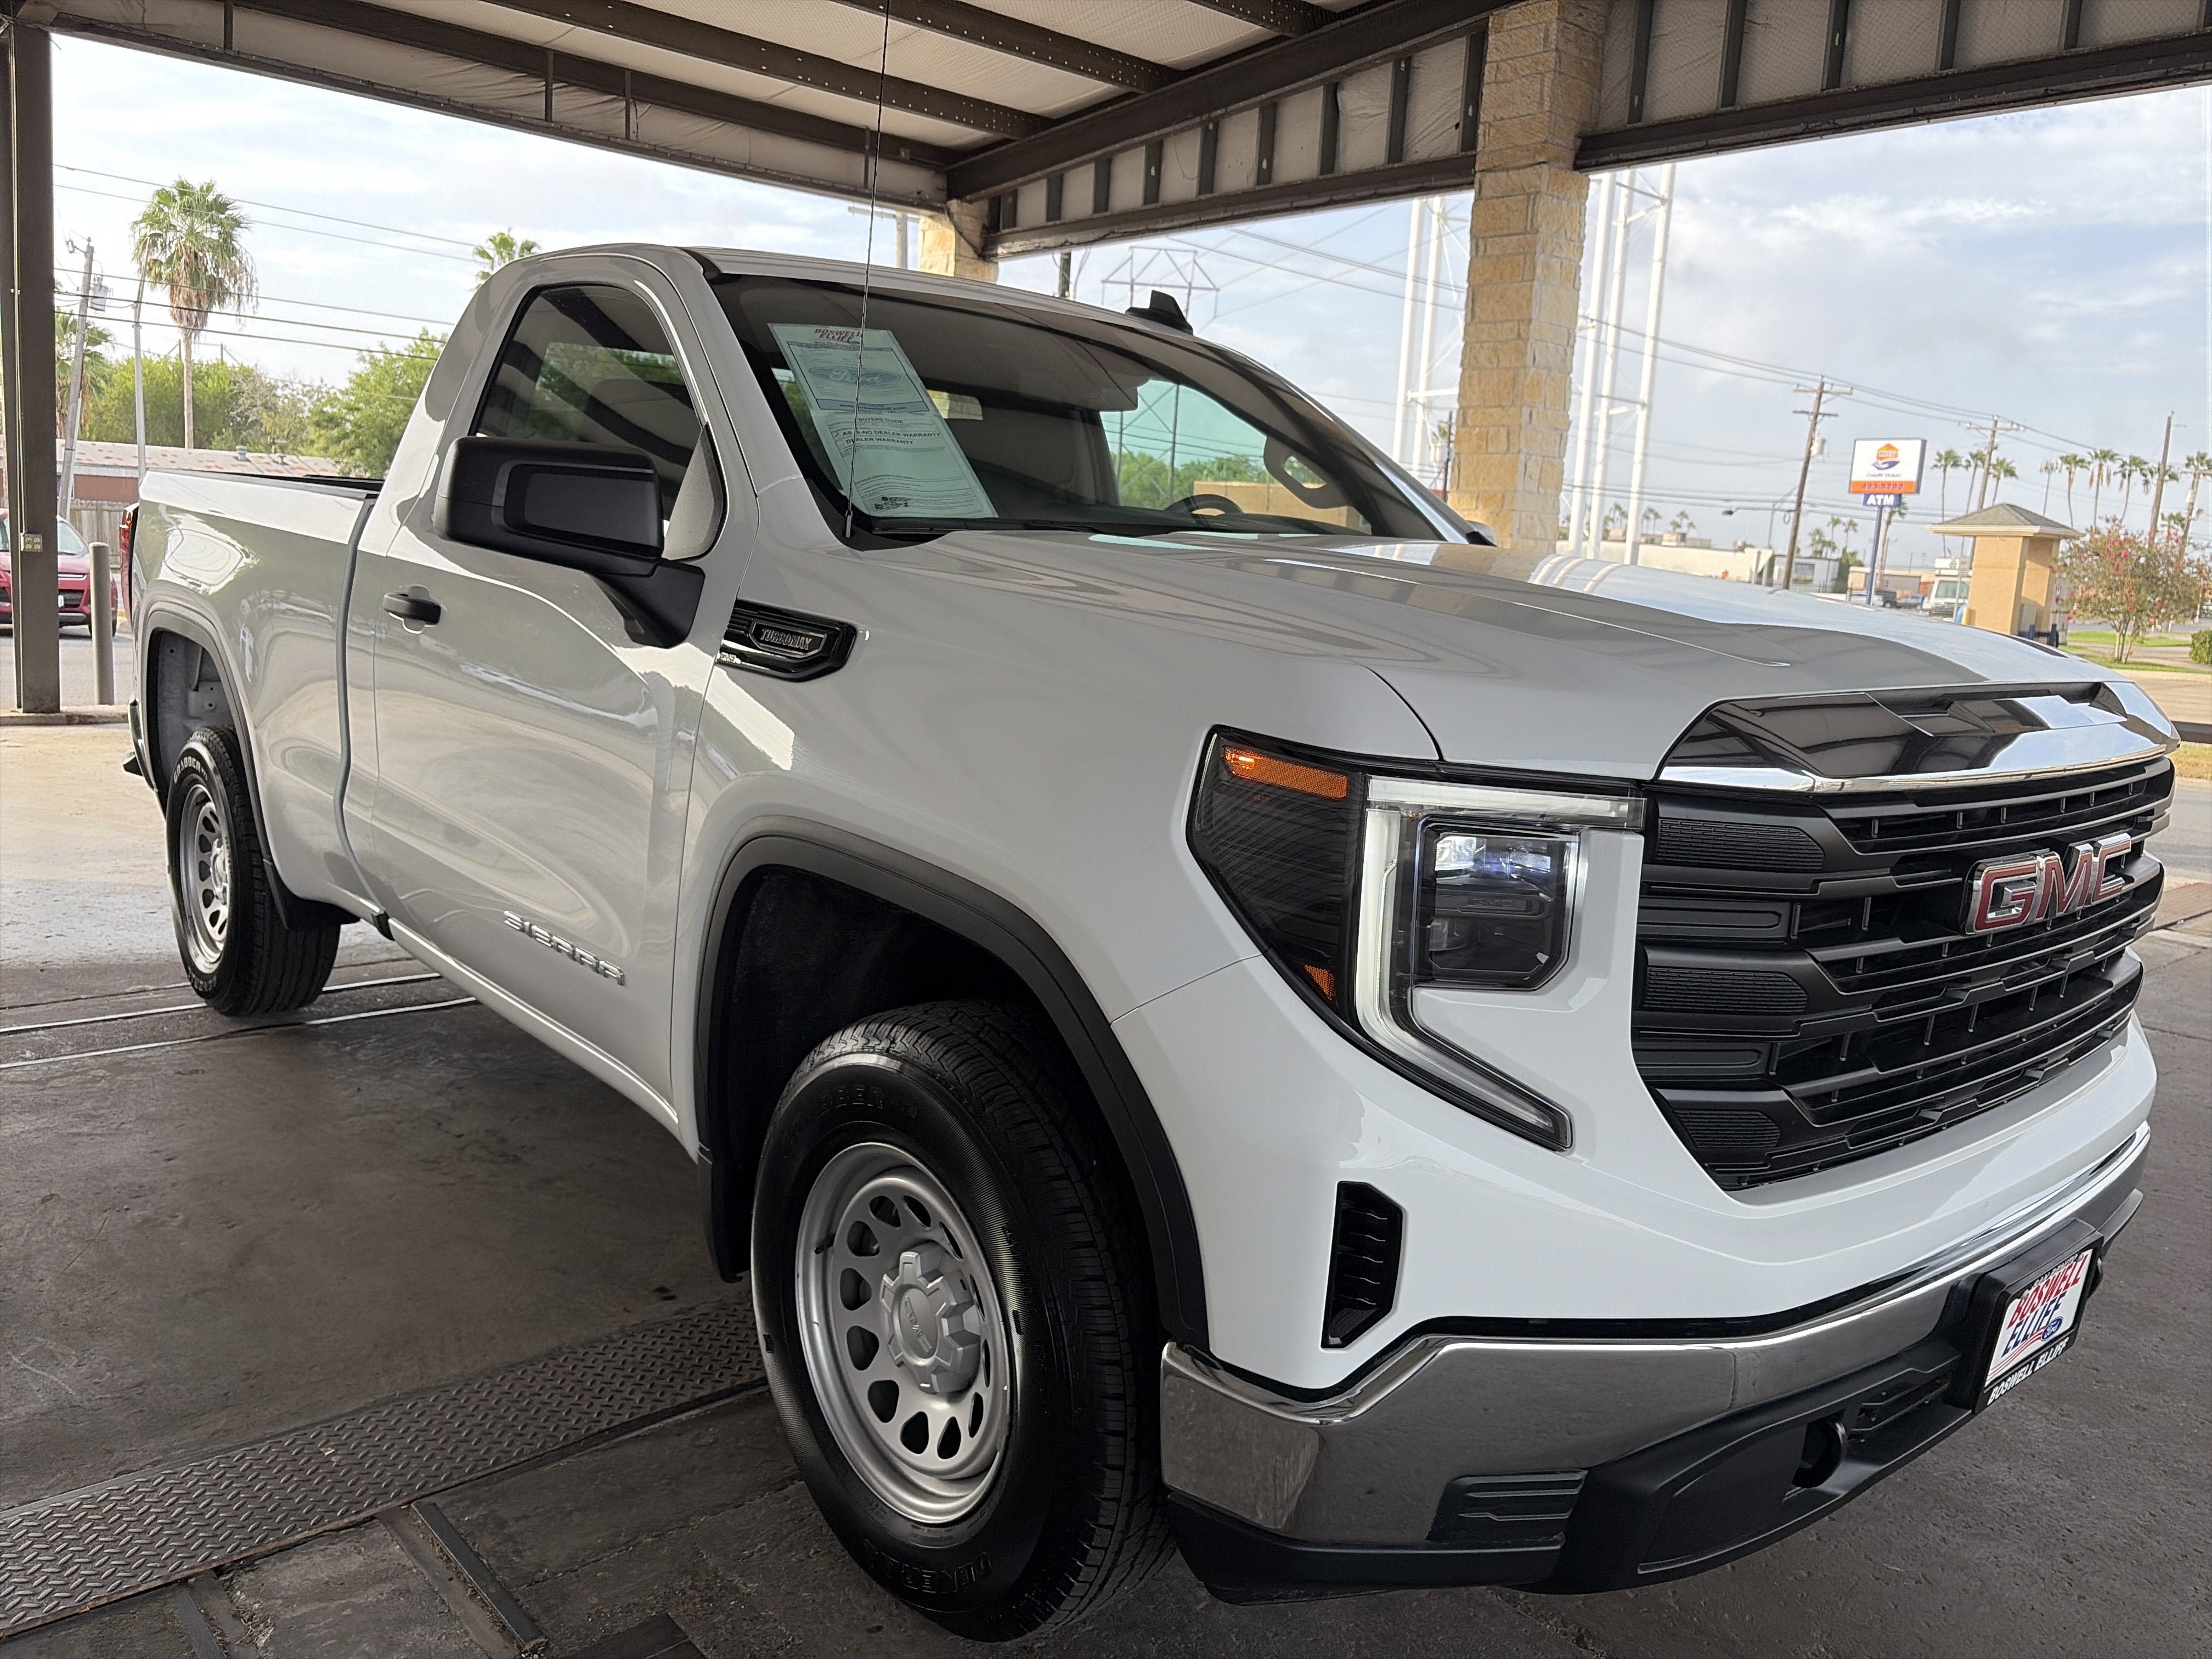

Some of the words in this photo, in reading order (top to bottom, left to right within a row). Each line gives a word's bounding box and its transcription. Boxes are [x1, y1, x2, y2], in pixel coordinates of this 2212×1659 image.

[814, 329, 862, 337] BOSWELL
[819, 334, 854, 342] ELLIFF
[1867, 494, 1894, 505] ATM
[760, 628, 813, 651] TURBOMAX
[173, 755, 201, 784] GRABBER
[1966, 833, 2132, 934] GMC
[503, 910, 625, 986] SIERRA
[2006, 1254, 2089, 1330] BOSWELL
[2001, 1290, 2068, 1358] ELLIFF
[1987, 1361, 2035, 1406] BOSWELL
[2033, 1336, 2070, 1371] ELLIFF
